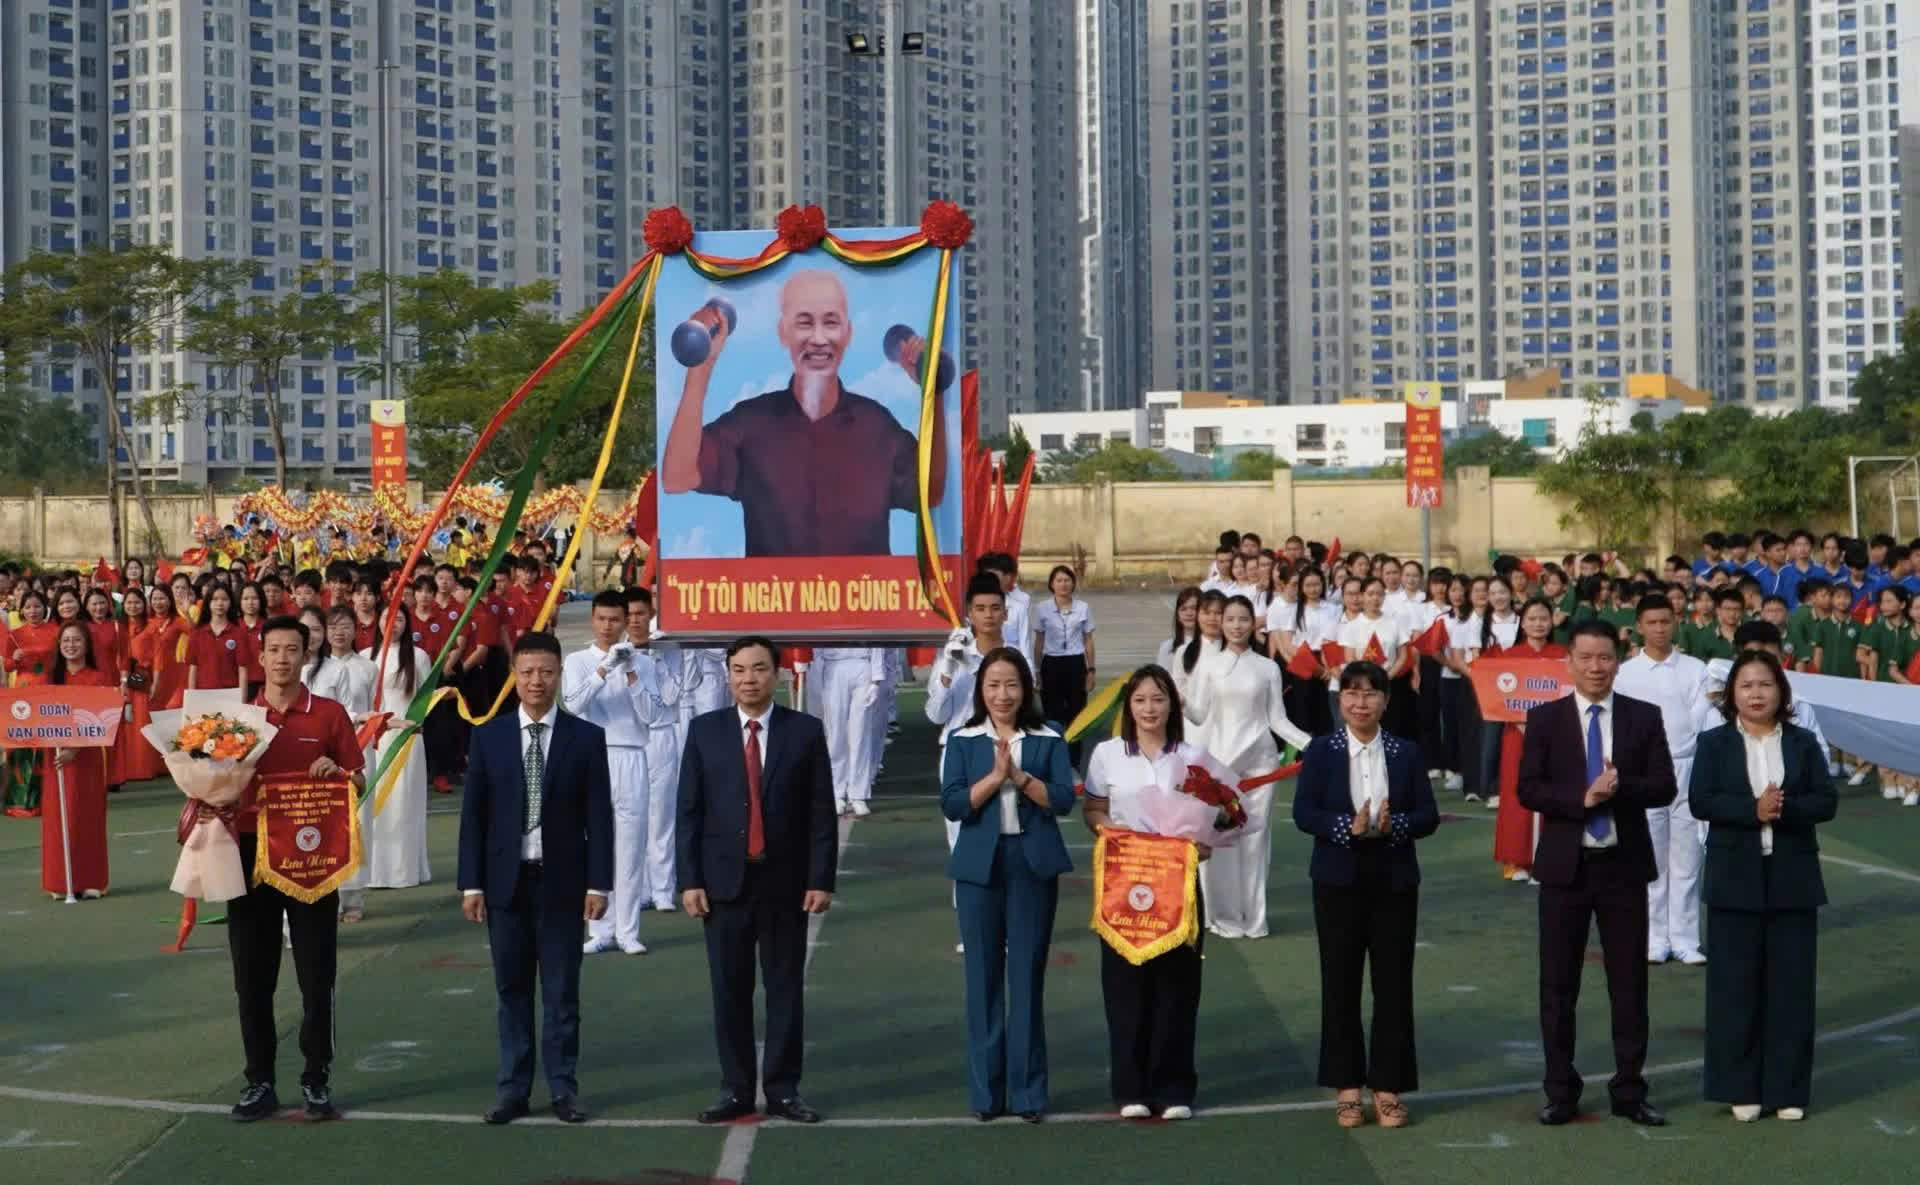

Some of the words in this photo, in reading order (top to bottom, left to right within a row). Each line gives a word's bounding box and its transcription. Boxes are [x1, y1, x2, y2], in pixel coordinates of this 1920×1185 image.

[706, 576, 737, 613] TÔI
[742, 575, 795, 613] NGÀY
[799, 575, 841, 613] NÀO
[846, 574, 901, 612] CŨNG
